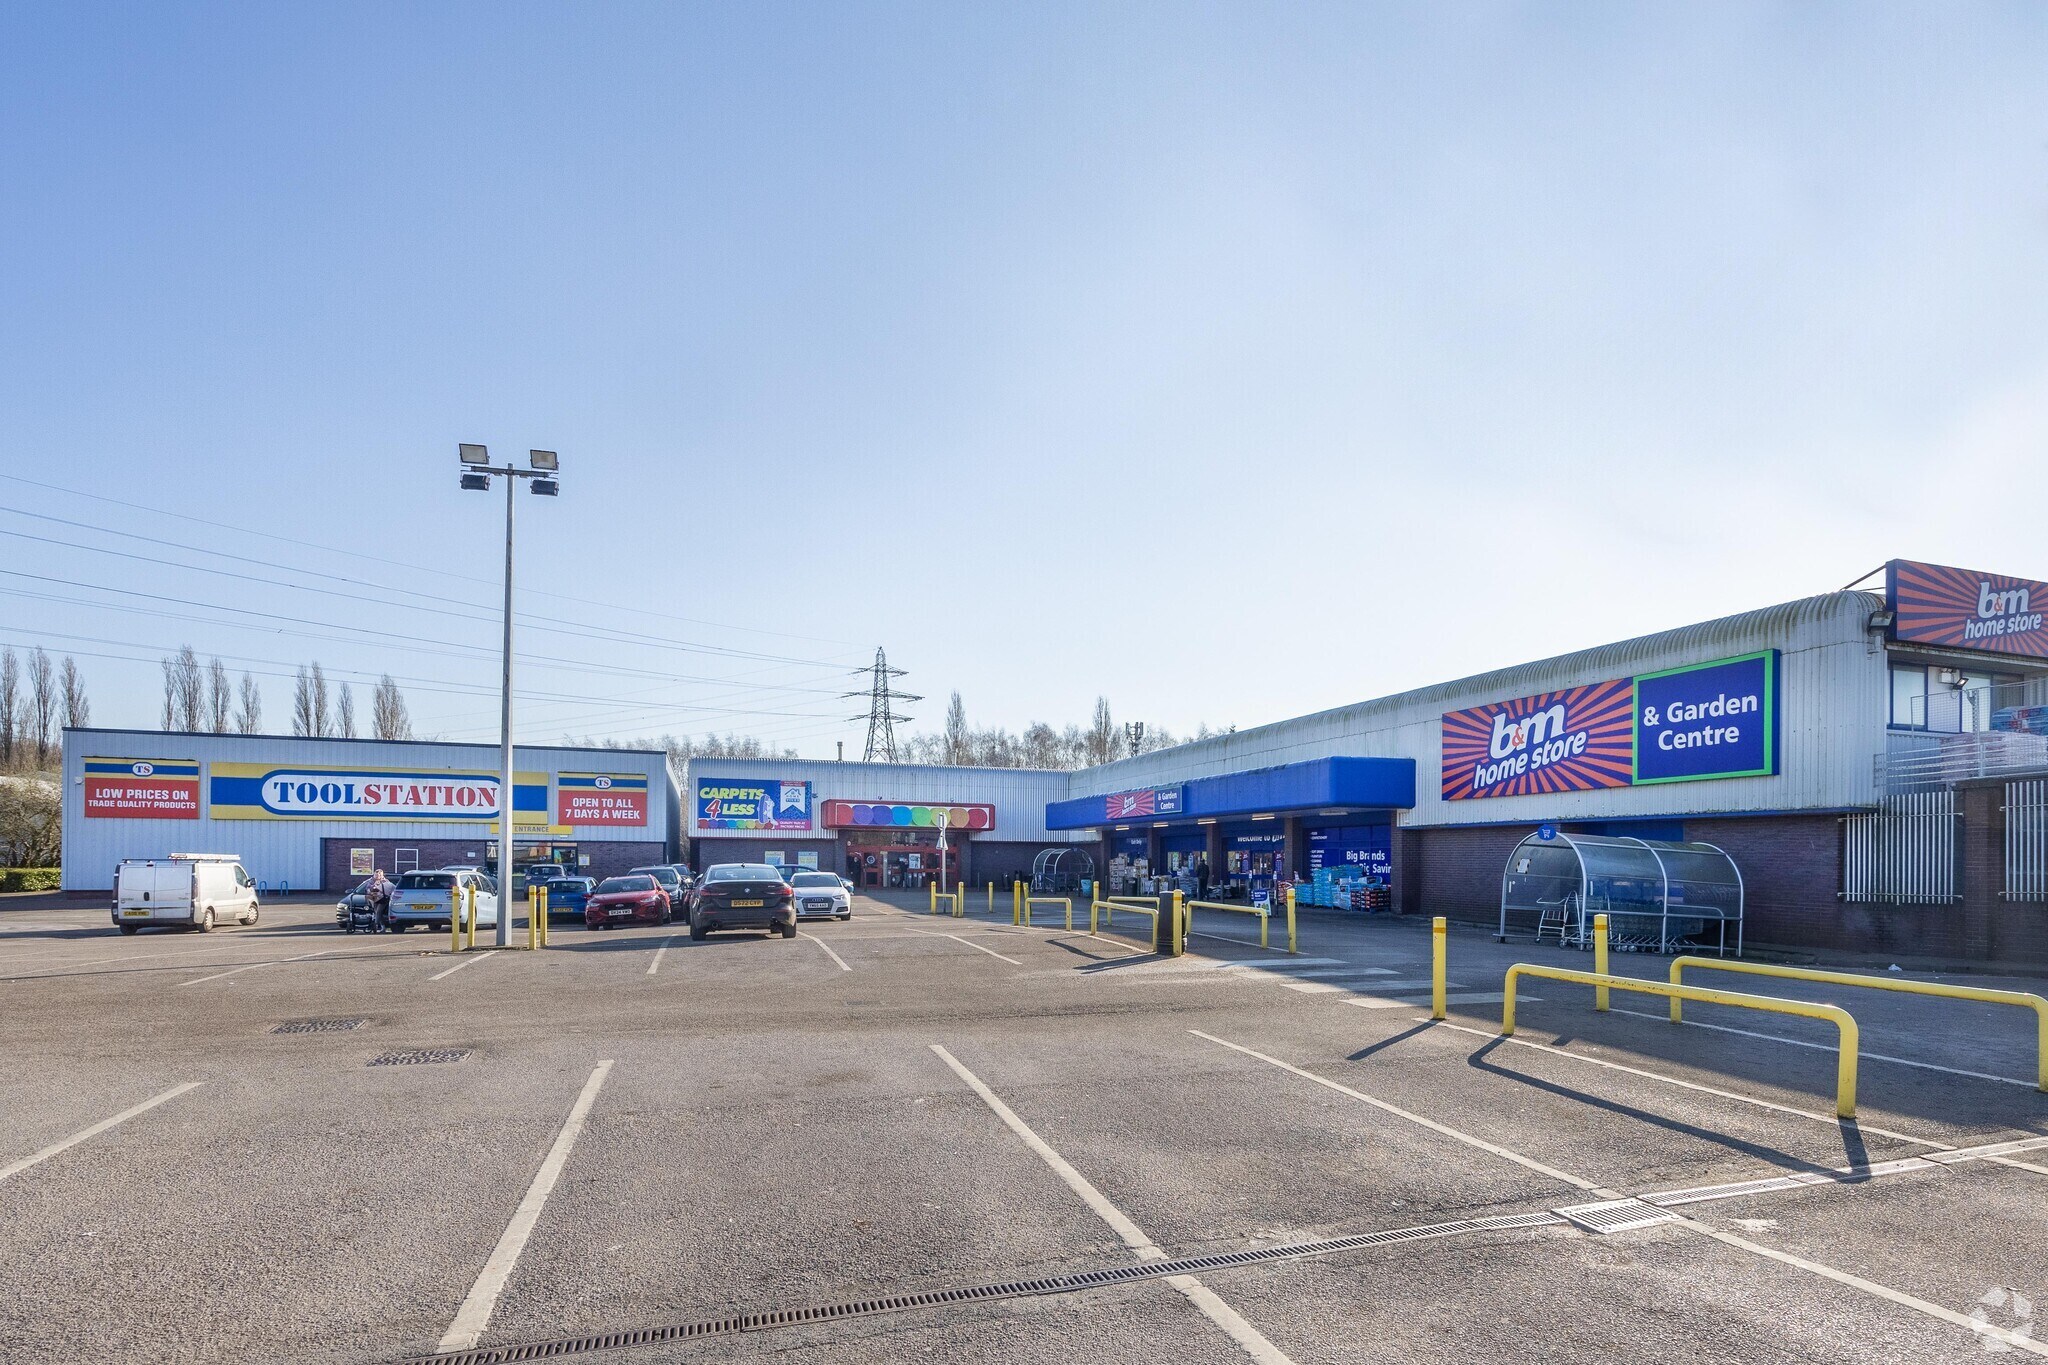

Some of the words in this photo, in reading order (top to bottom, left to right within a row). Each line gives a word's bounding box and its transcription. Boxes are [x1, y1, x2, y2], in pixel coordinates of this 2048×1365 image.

[1978, 582, 2030, 618] b&m
[1964, 619, 2005, 639] home
[2007, 613, 2042, 634] store
[1643, 706, 1660, 727] &
[1667, 693, 1758, 724] Garden
[1489, 704, 1566, 759] b&m
[1658, 726, 1740, 751] Centre
[1474, 757, 1526, 790] home
[1531, 732, 1587, 770] store
[135, 766, 151, 774] TS
[96, 788, 124, 798] LOW
[126, 789, 169, 800] PRICES
[172, 790, 189, 800] ON
[273, 782, 498, 808] TOOLSTATION
[700, 788, 765, 800] CARPETS
[1162, 791, 1178, 800] Garden
[572, 798, 599, 807] OPEN
[601, 798, 613, 808] TO
[616, 799, 633, 808] ALL
[706, 799, 721, 818] 4
[722, 804, 755, 815] LESS
[1160, 801, 1174, 810] Centre
[566, 809, 571, 818] 7
[574, 809, 600, 818] DAYS
[602, 810, 609, 818] A
[612, 810, 640, 819] WEEK
[1346, 850, 1358, 862] Big
